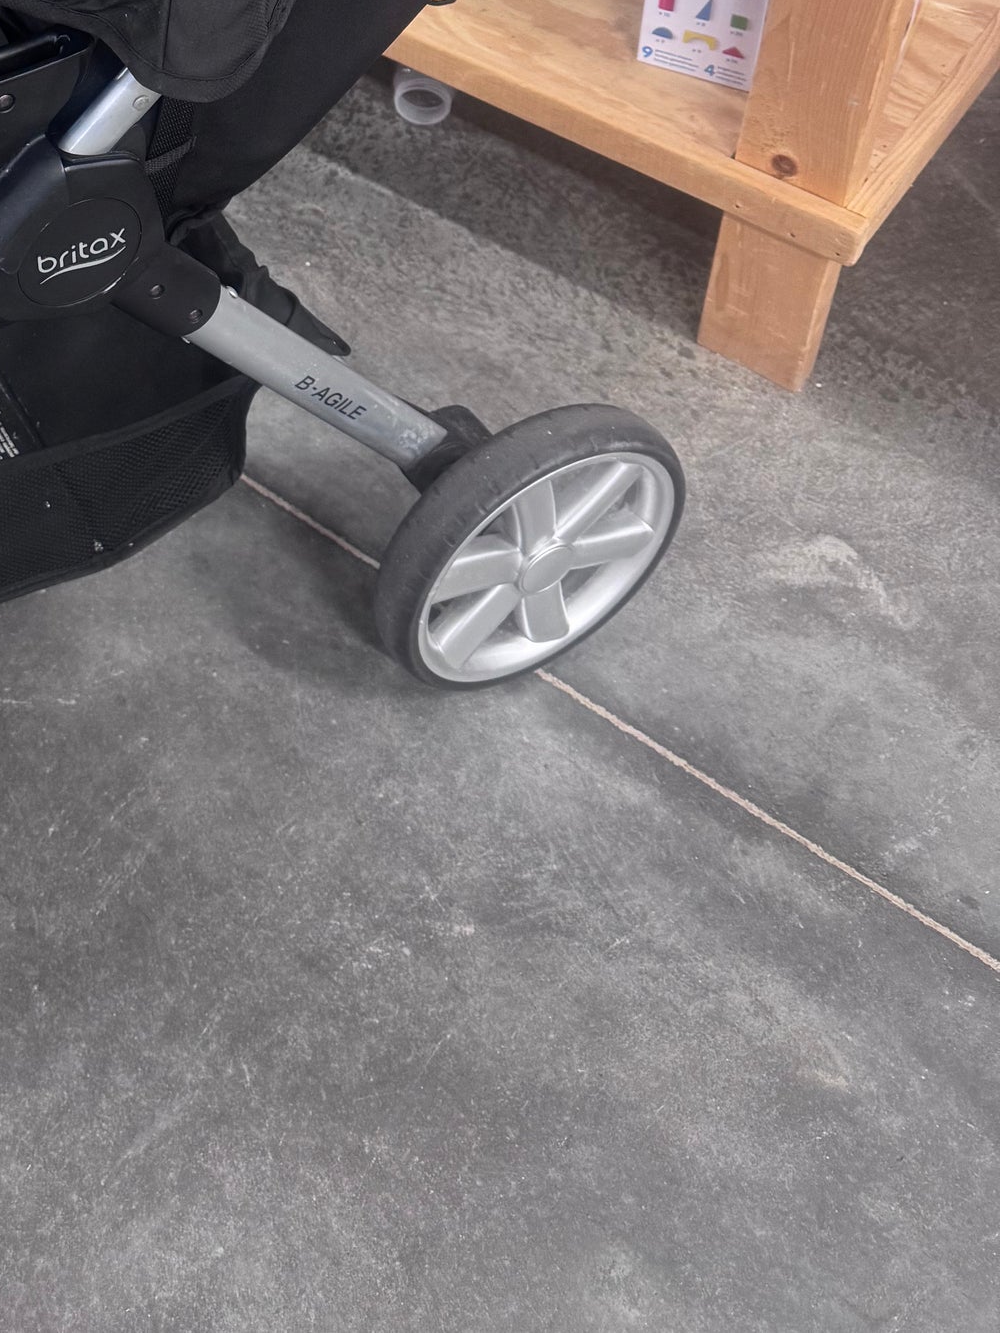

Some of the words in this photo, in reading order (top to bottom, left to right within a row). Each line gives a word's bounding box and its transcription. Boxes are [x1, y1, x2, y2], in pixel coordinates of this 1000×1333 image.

[642, 46, 653, 58] 9
[704, 64, 715, 76] 4
[37, 227, 126, 275] britax
[294, 375, 368, 421] B-AGILE
